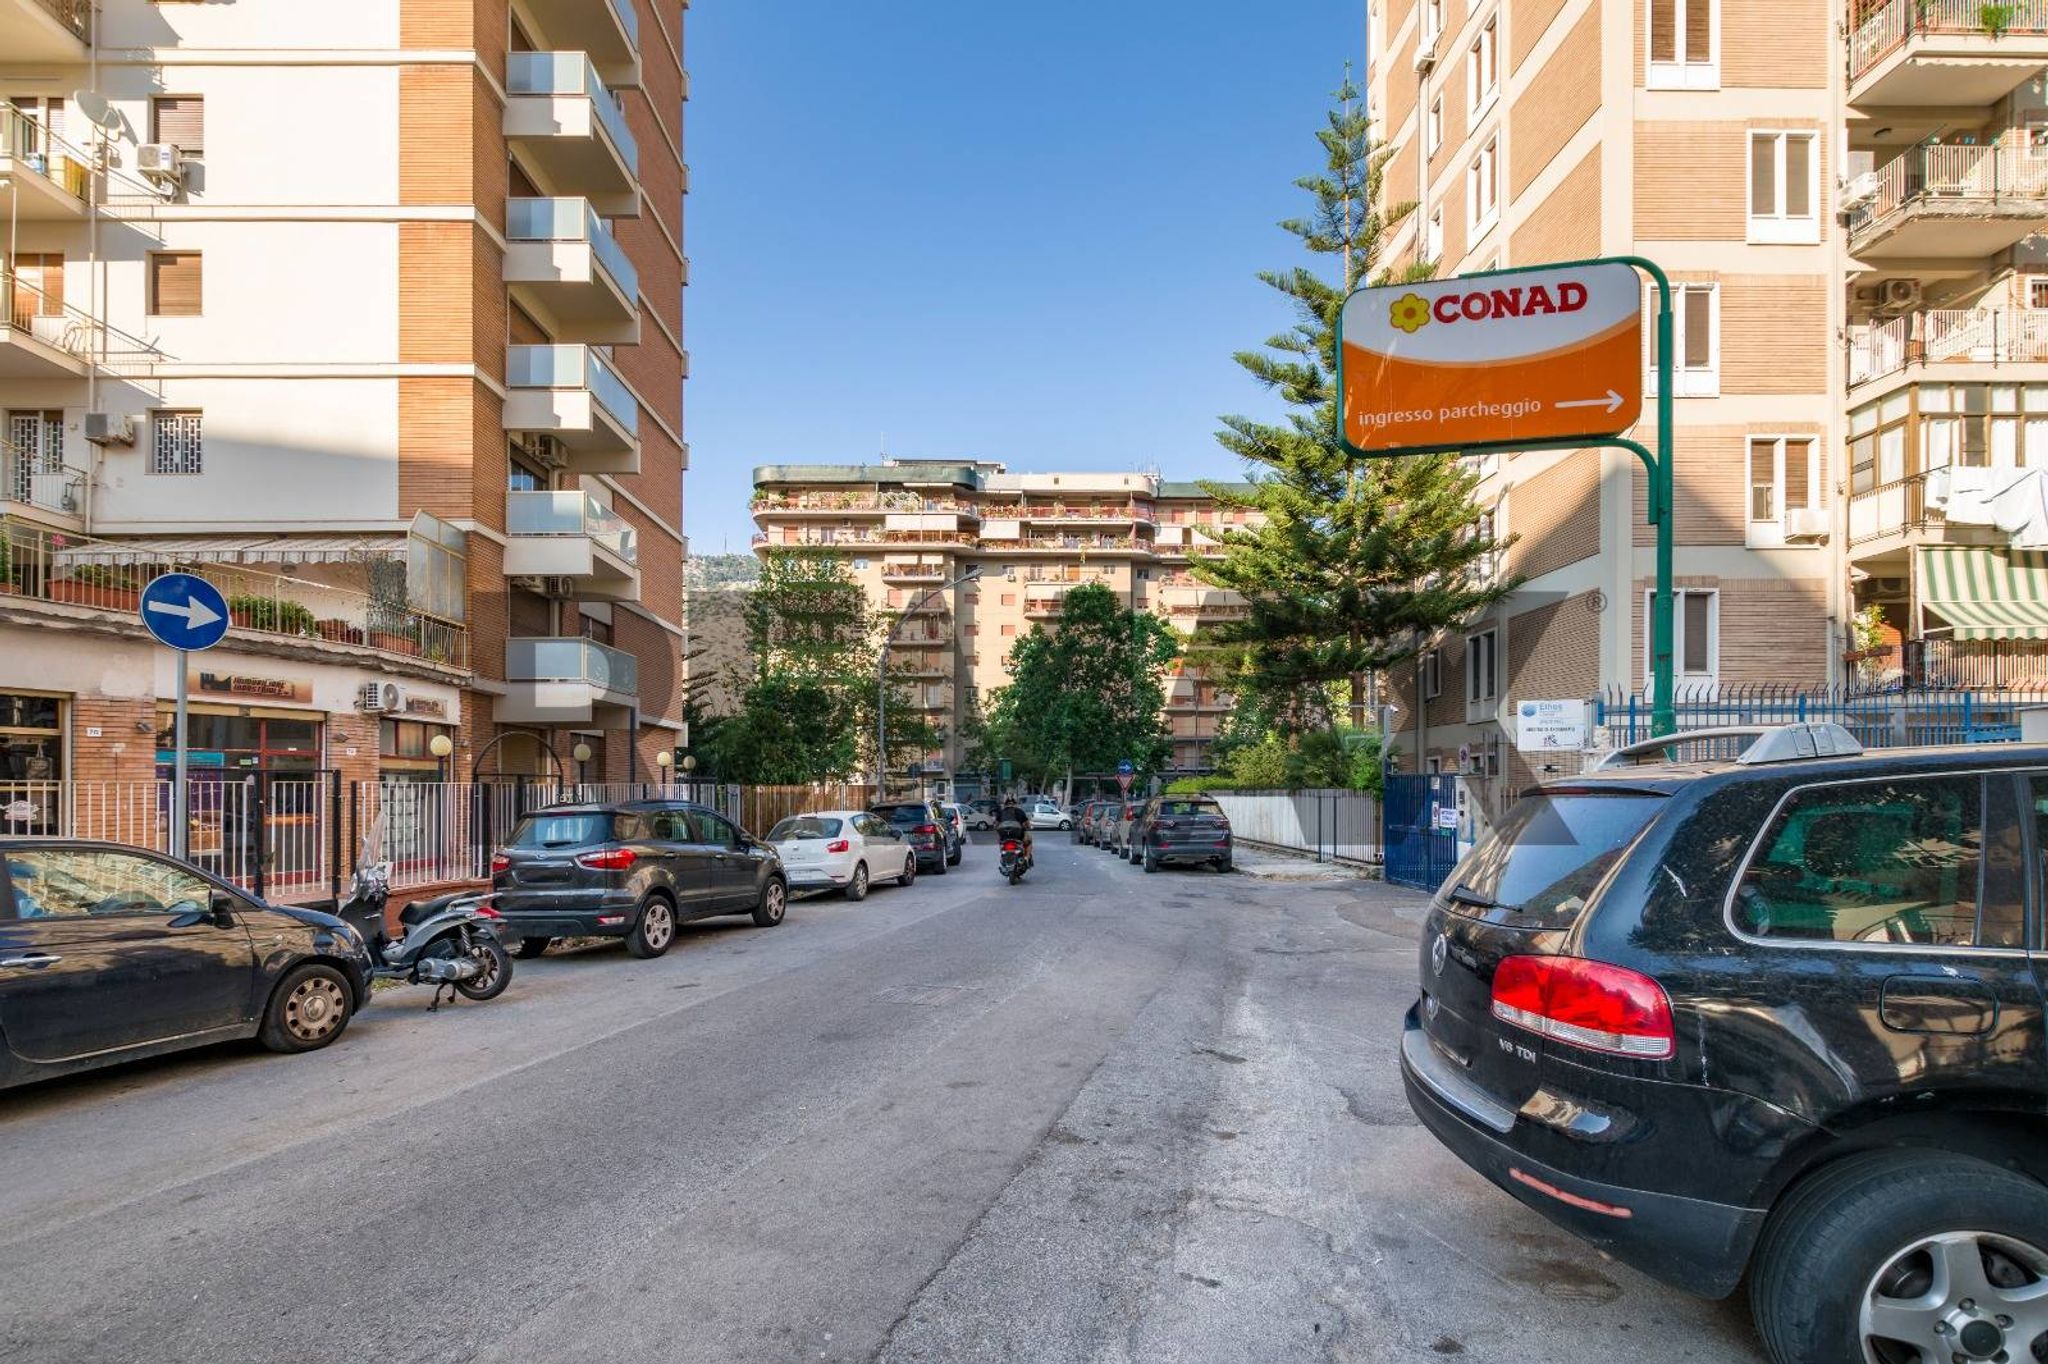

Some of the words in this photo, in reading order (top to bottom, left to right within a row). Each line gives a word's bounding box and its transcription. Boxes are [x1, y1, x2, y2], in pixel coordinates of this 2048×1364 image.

[1433, 282, 1588, 325] CONAD
[1358, 407, 1434, 428] ingresso
[1439, 398, 1541, 424] parcheggio
[1498, 1038, 1514, 1053] V6
[1515, 1045, 1537, 1064] TDI
